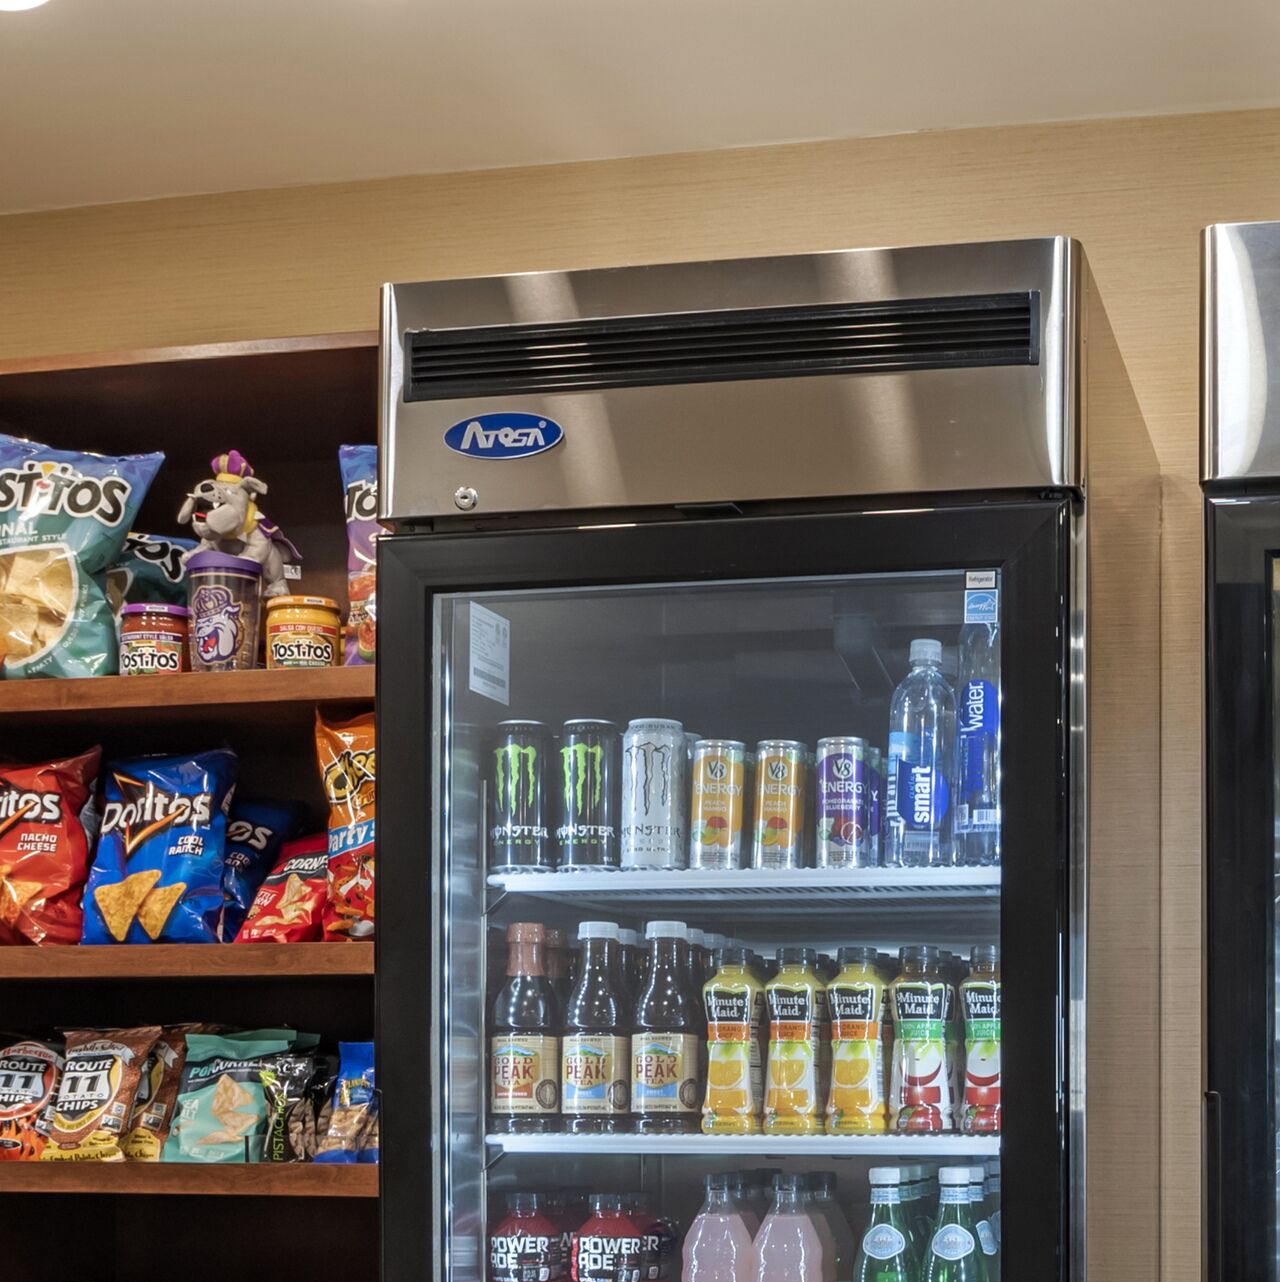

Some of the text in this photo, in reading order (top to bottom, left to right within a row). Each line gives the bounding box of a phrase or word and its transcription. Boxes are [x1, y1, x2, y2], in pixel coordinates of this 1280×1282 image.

[273, 640, 331, 660] TOSTITOS
[708, 760, 725, 778] V8
[769, 761, 785, 778] V8
[835, 759, 851, 777] V8
[913, 765, 930, 823] smart
[101, 782, 211, 834] Doritos
[21, 833, 57, 842] NACHO
[178, 836, 204, 846] COOL
[17, 842, 57, 852] CHEESE
[168, 846, 203, 856] RANCH
[898, 990, 940, 1005] Minute
[904, 1003, 935, 1015] Maid
[0, 1059, 47, 1072] ROUTE
[65, 1059, 114, 1071] ROUTE
[495, 1057, 533, 1065] GOLD
[636, 1055, 677, 1064] GOLD
[495, 1065, 534, 1080] PEAK
[567, 1065, 606, 1080] PEAK
[636, 1063, 678, 1078] PEAK
[65, 1074, 102, 1093] 11
[56, 1100, 99, 1111] CHIPS
[491, 1236, 549, 1253] POWER
[579, 1238, 641, 1254] POWER
[491, 1253, 519, 1269] ADE
[578, 1253, 614, 1270] ADE
